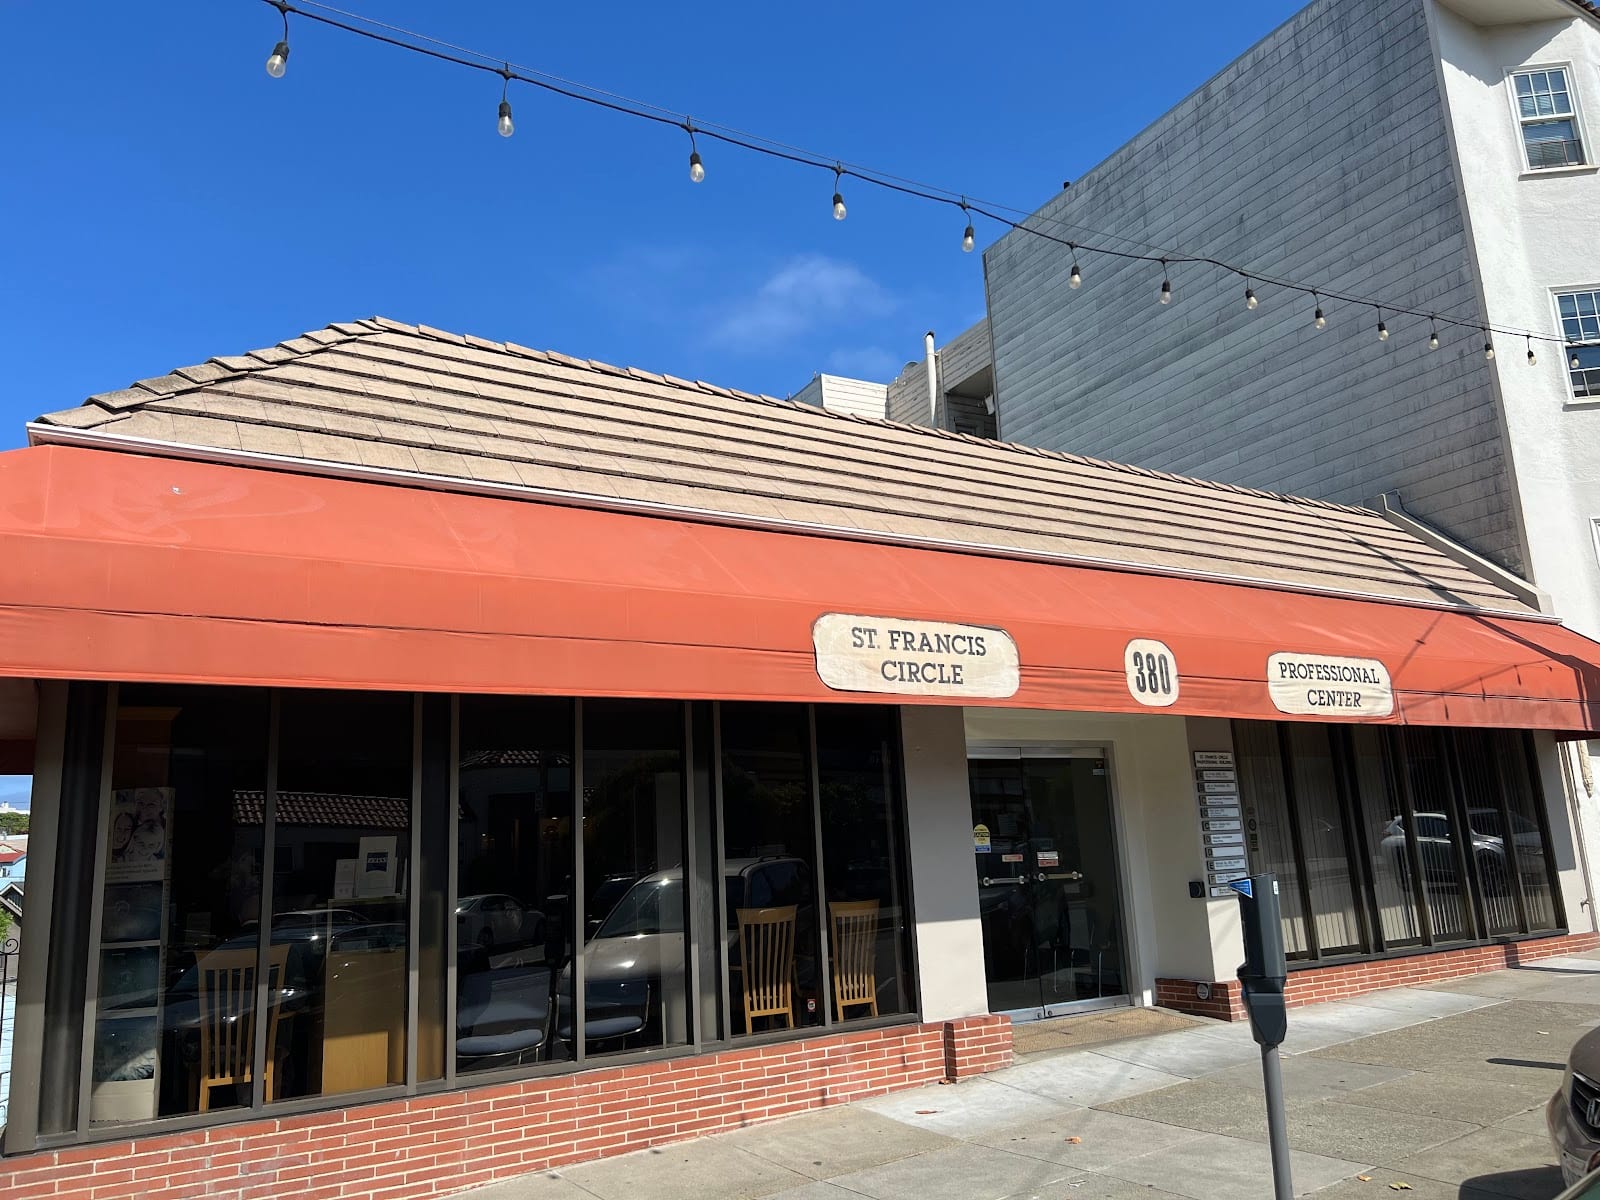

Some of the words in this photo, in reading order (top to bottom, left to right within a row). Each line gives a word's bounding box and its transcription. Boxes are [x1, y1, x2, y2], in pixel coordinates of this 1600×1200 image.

[851, 626, 881, 649] ST.
[888, 629, 987, 656] FRANCIS
[880, 659, 963, 685] CIRCLE
[1133, 651, 1171, 695] 380
[1278, 661, 1380, 684] PROFESSIONAL
[1307, 689, 1362, 708] CENTER
